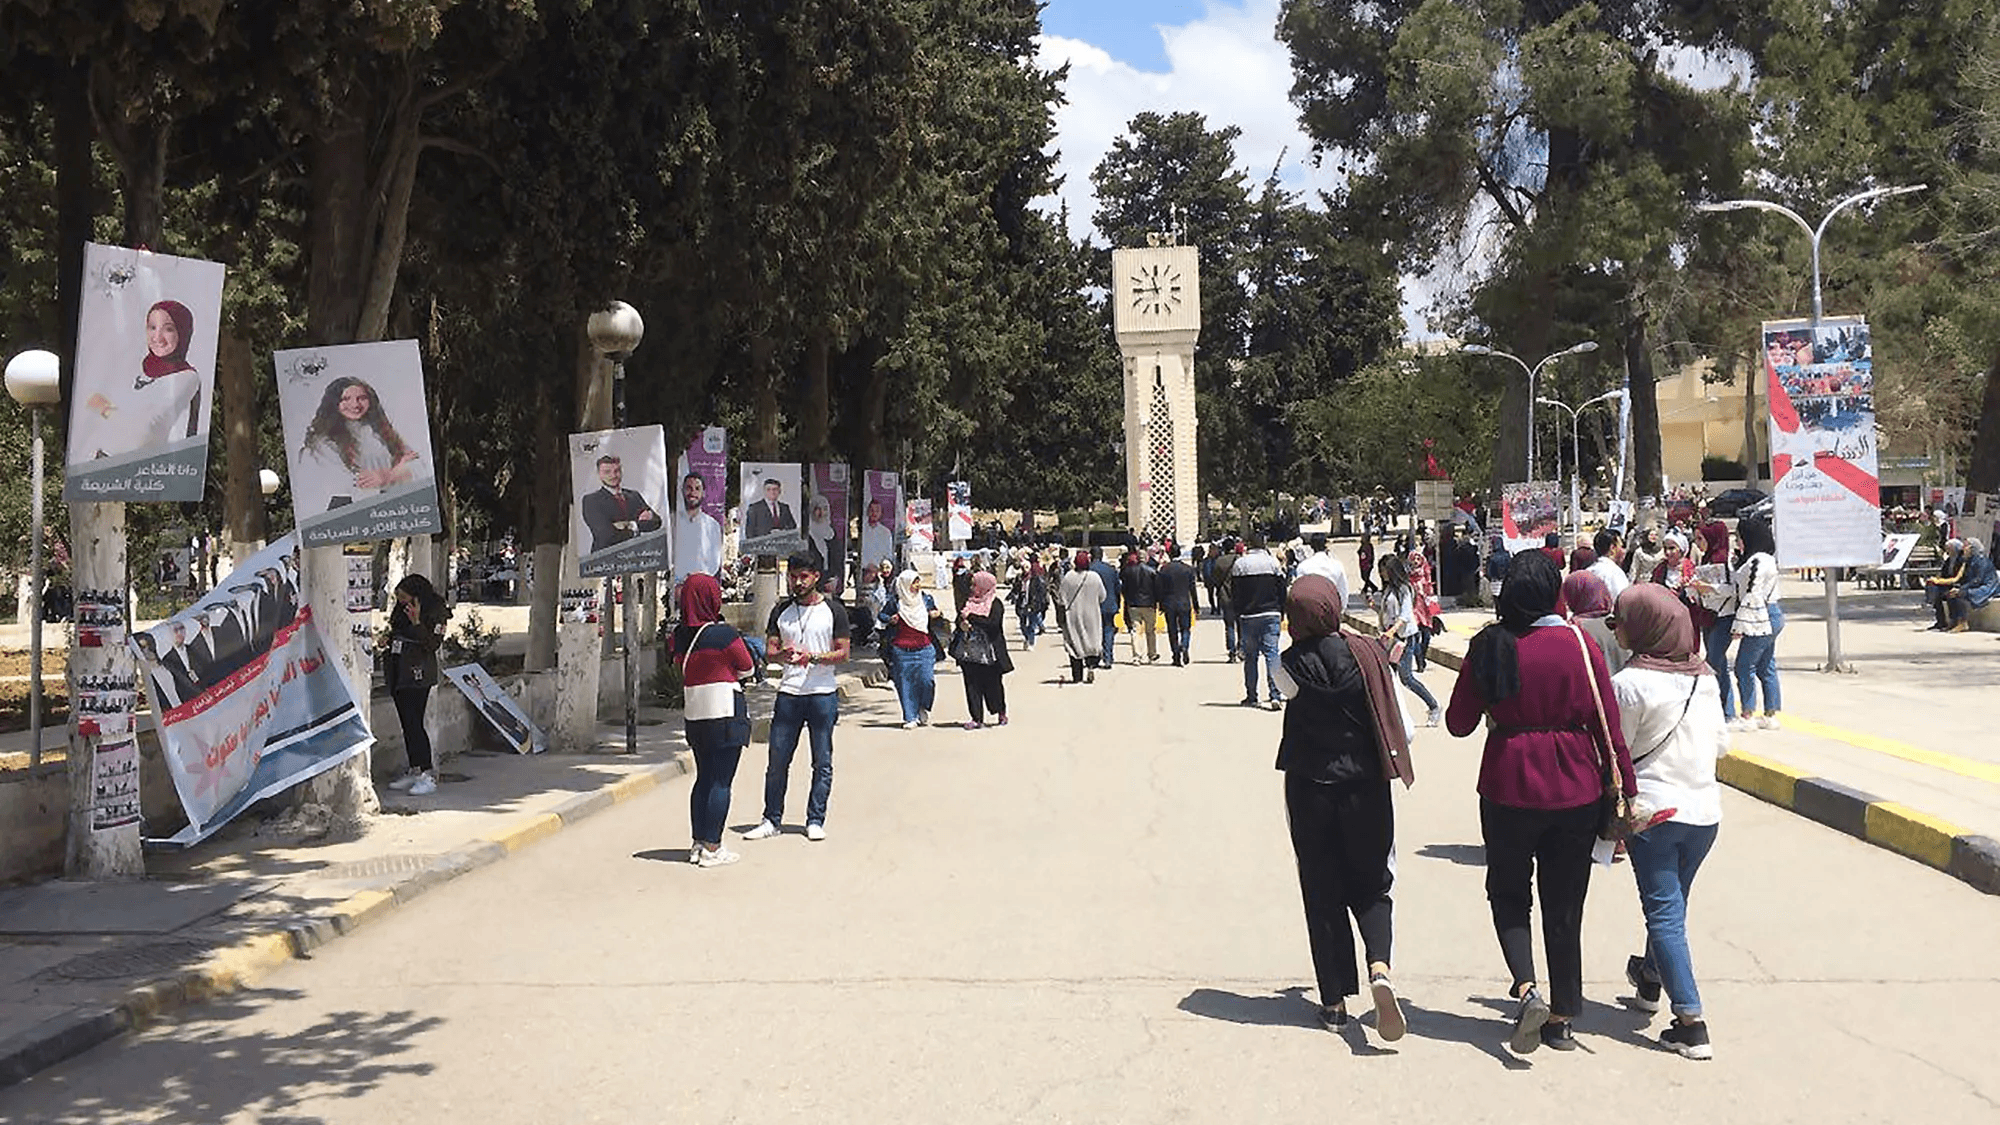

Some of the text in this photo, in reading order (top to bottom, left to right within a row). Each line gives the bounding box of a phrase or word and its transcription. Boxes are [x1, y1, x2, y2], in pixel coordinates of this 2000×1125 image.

[178, 463, 198, 476] دانا
[81, 478, 165, 494] كلية الشريعة
[400, 517, 432, 532] كلية
